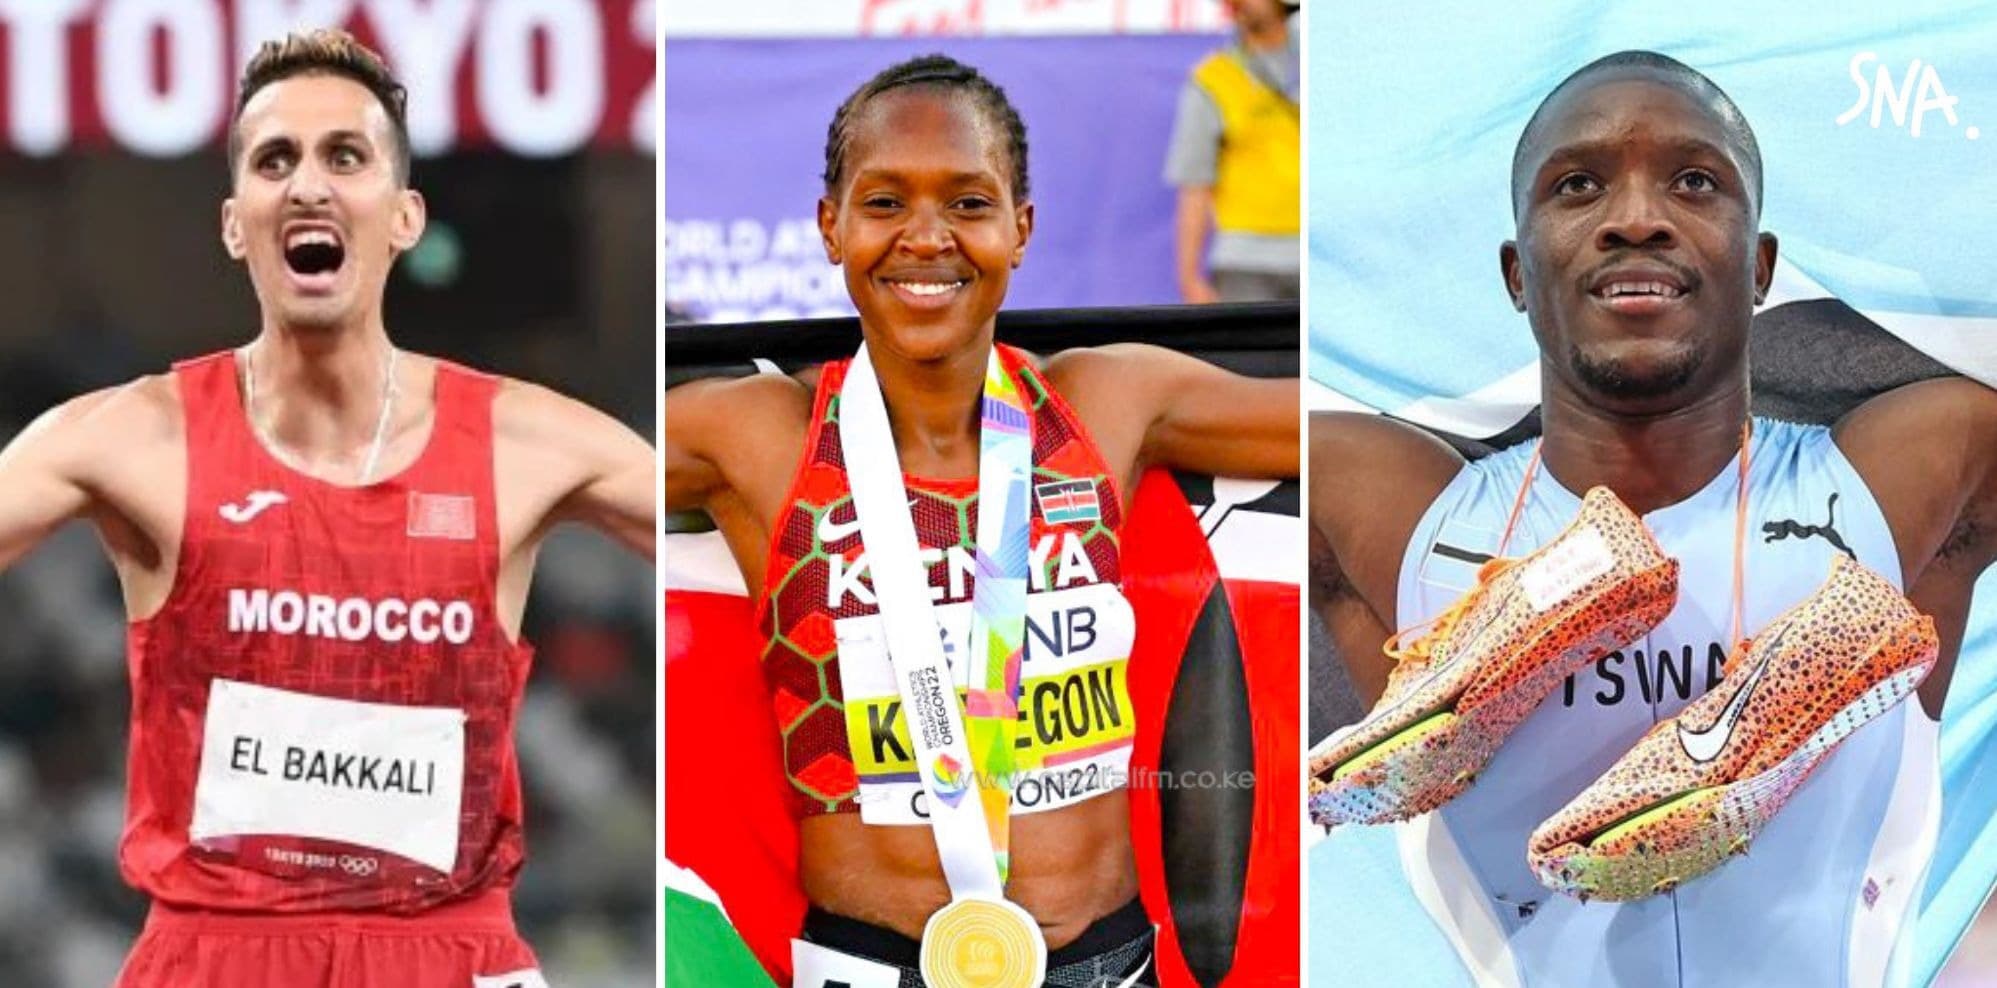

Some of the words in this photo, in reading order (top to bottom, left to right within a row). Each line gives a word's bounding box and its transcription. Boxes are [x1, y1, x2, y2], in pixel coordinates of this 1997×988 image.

[228, 589, 474, 645] MOROCCO
[230, 736, 268, 775] EL
[283, 746, 434, 796] BAKKALI
